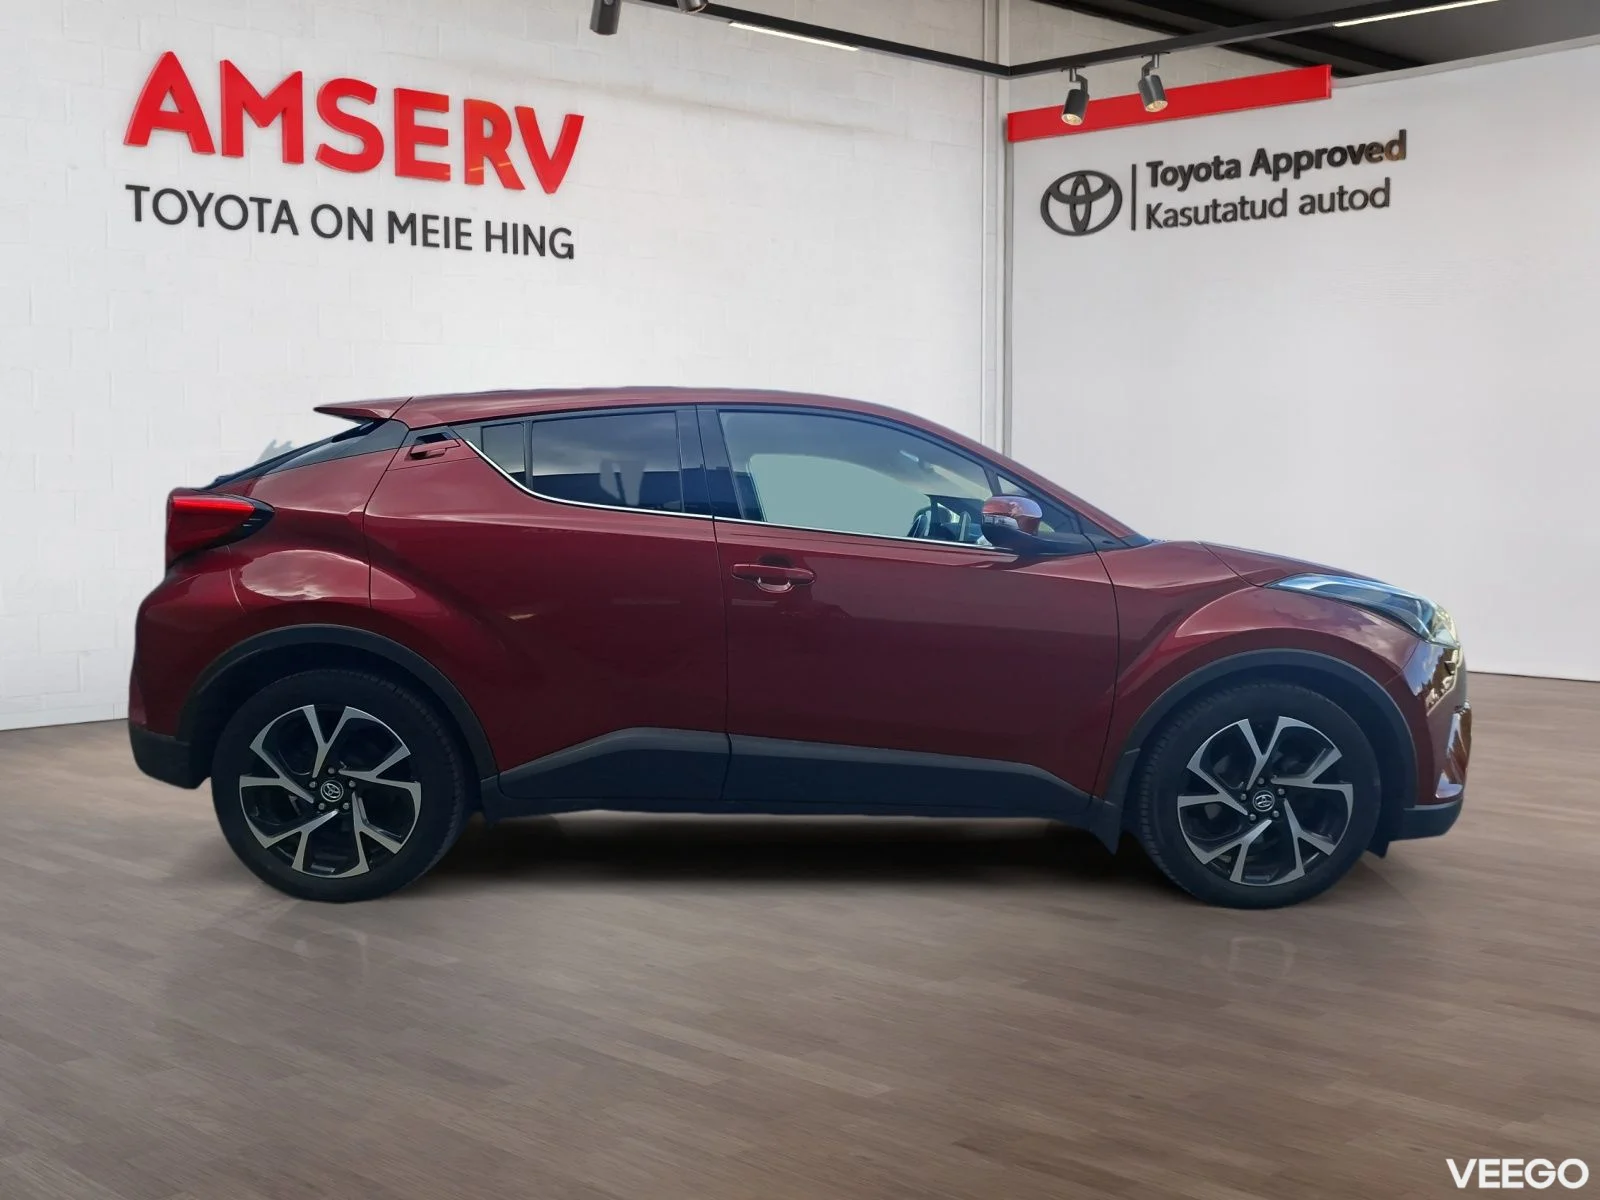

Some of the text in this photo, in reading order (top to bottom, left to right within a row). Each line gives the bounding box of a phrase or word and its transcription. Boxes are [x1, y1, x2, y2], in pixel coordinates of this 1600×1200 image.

[123, 50, 585, 195] AMSERV
[1145, 129, 1408, 193] Toyota Approved
[124, 183, 575, 260] TOYOTA ON MEIE HING
[1145, 176, 1391, 231] Kasutatud autod
